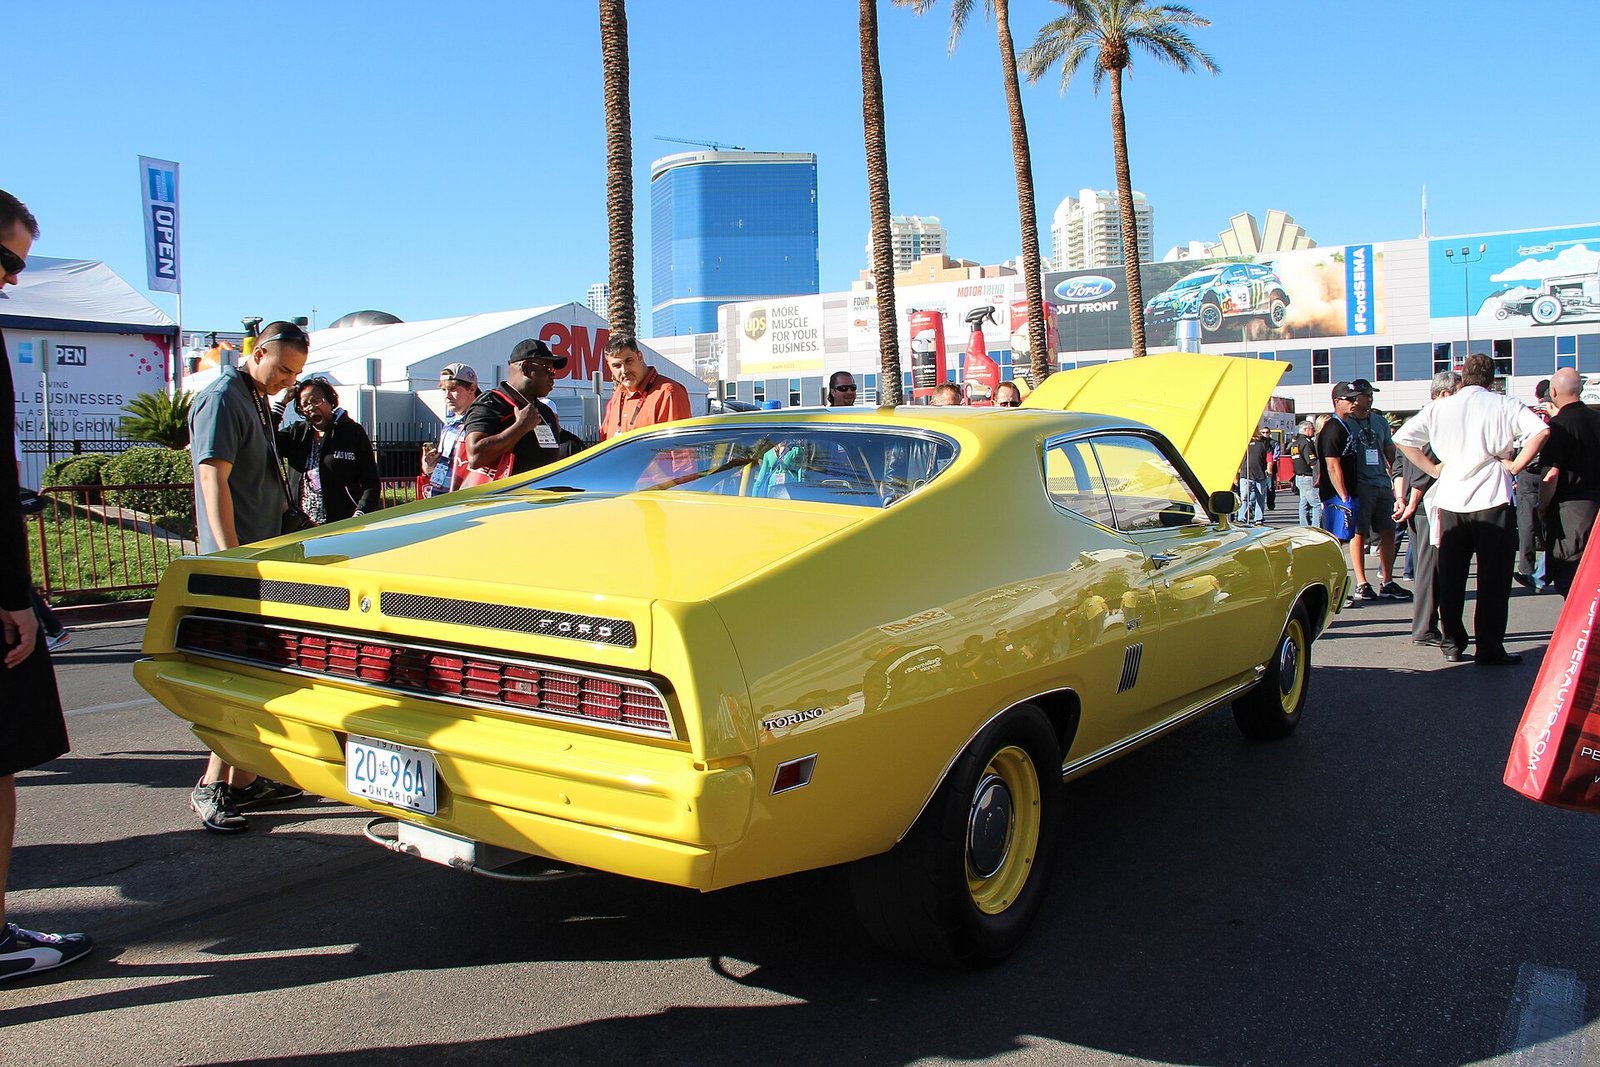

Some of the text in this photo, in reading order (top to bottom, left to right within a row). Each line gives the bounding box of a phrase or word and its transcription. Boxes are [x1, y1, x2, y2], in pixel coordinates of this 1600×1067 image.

[155, 210, 174, 276] OPEN
[957, 284, 1005, 298] MOTOR TREND
[1066, 281, 1104, 297] Ford
[1353, 247, 1368, 334] #FordSEMA
[853, 297, 869, 306] FOUR
[1079, 301, 1119, 313] FRONT
[771, 306, 800, 317] MORE
[744, 317, 766, 336] ups
[771, 317, 809, 330] MUSCLE
[771, 329, 818, 341] FOR YOUR
[57, 347, 85, 363] PEN
[539, 322, 613, 382] 3M
[771, 341, 820, 354] BUSINESS.
[38, 381, 69, 389] GVING
[35, 392, 123, 405] BUSINESSES
[68, 409, 79, 417] TO
[539, 619, 612, 637] FORD
[763, 707, 825, 731] TORINO
[355, 746, 426, 797] 20 96A
[368, 785, 413, 804] ONTARIO
